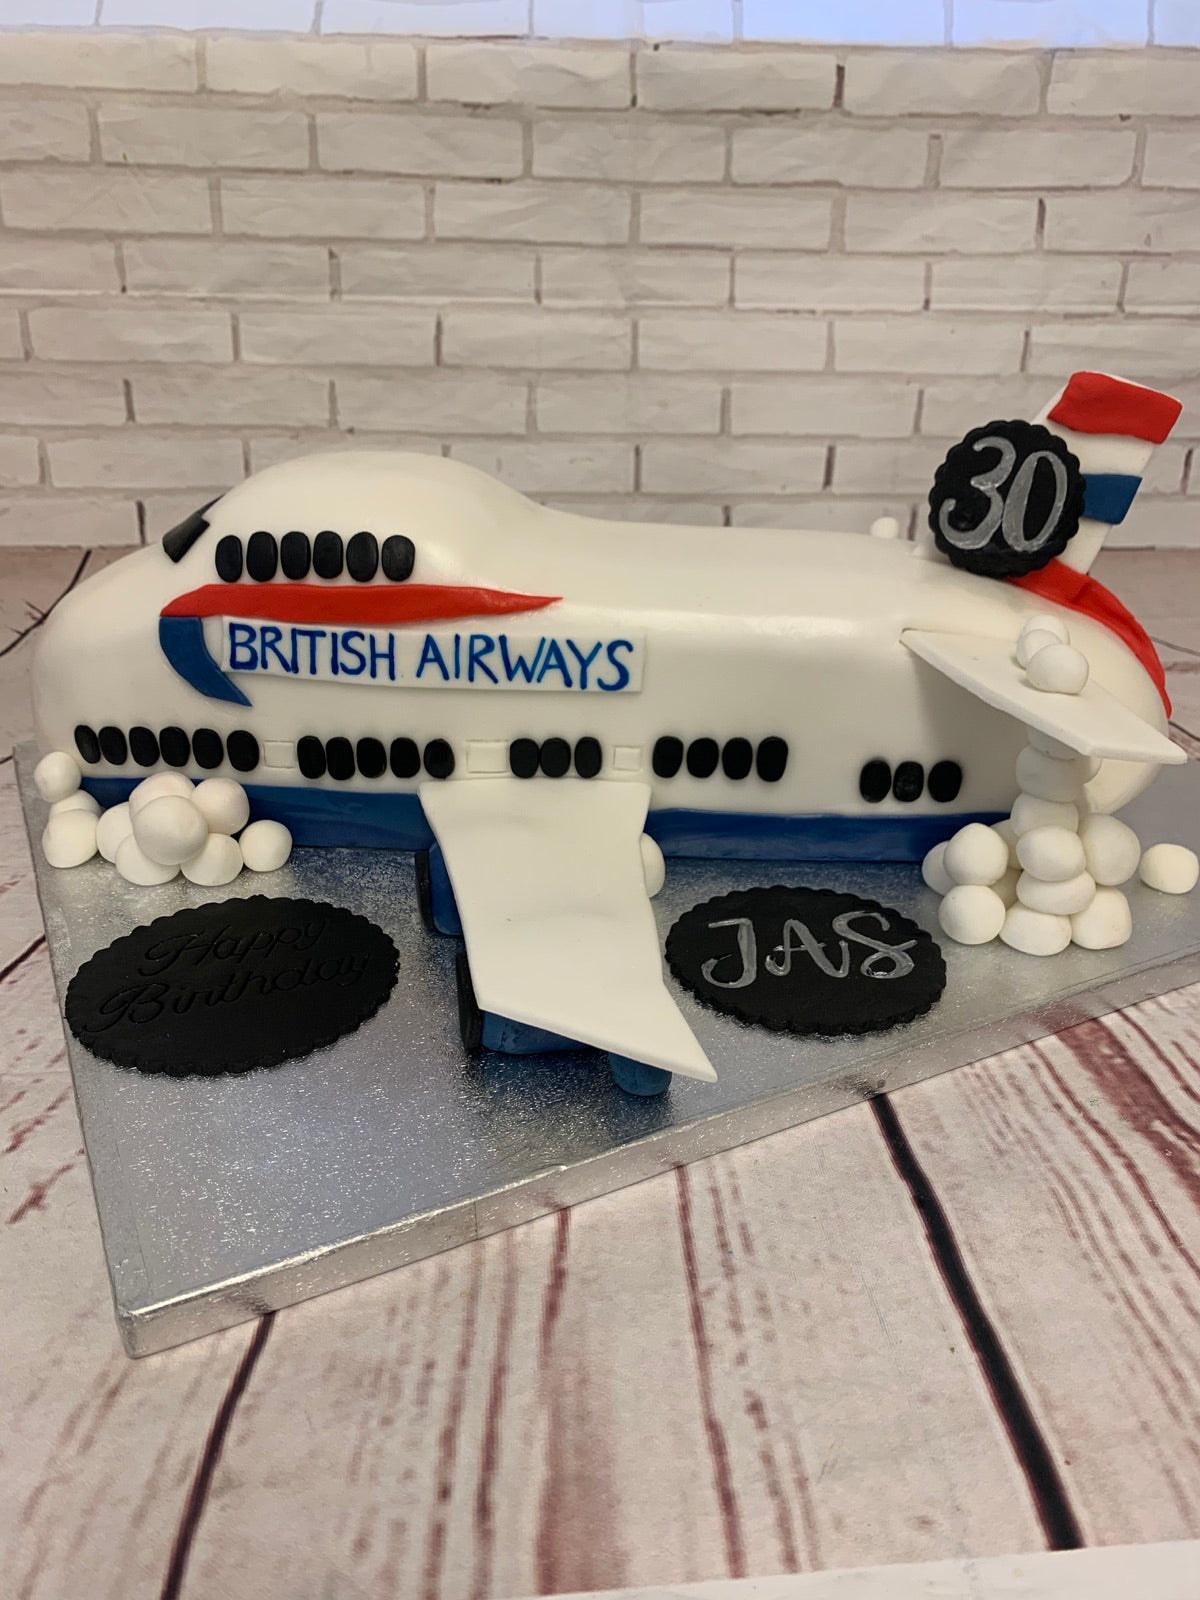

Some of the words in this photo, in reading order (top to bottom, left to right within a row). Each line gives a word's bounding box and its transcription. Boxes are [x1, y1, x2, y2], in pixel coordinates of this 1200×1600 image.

[939, 436, 1067, 552] 30
[228, 622, 396, 681] BRITISH
[416, 632, 634, 691] AIRWAYS
[137, 919, 328, 977] Happy
[701, 910, 918, 989] JAS
[82, 951, 369, 1033] Birthday
